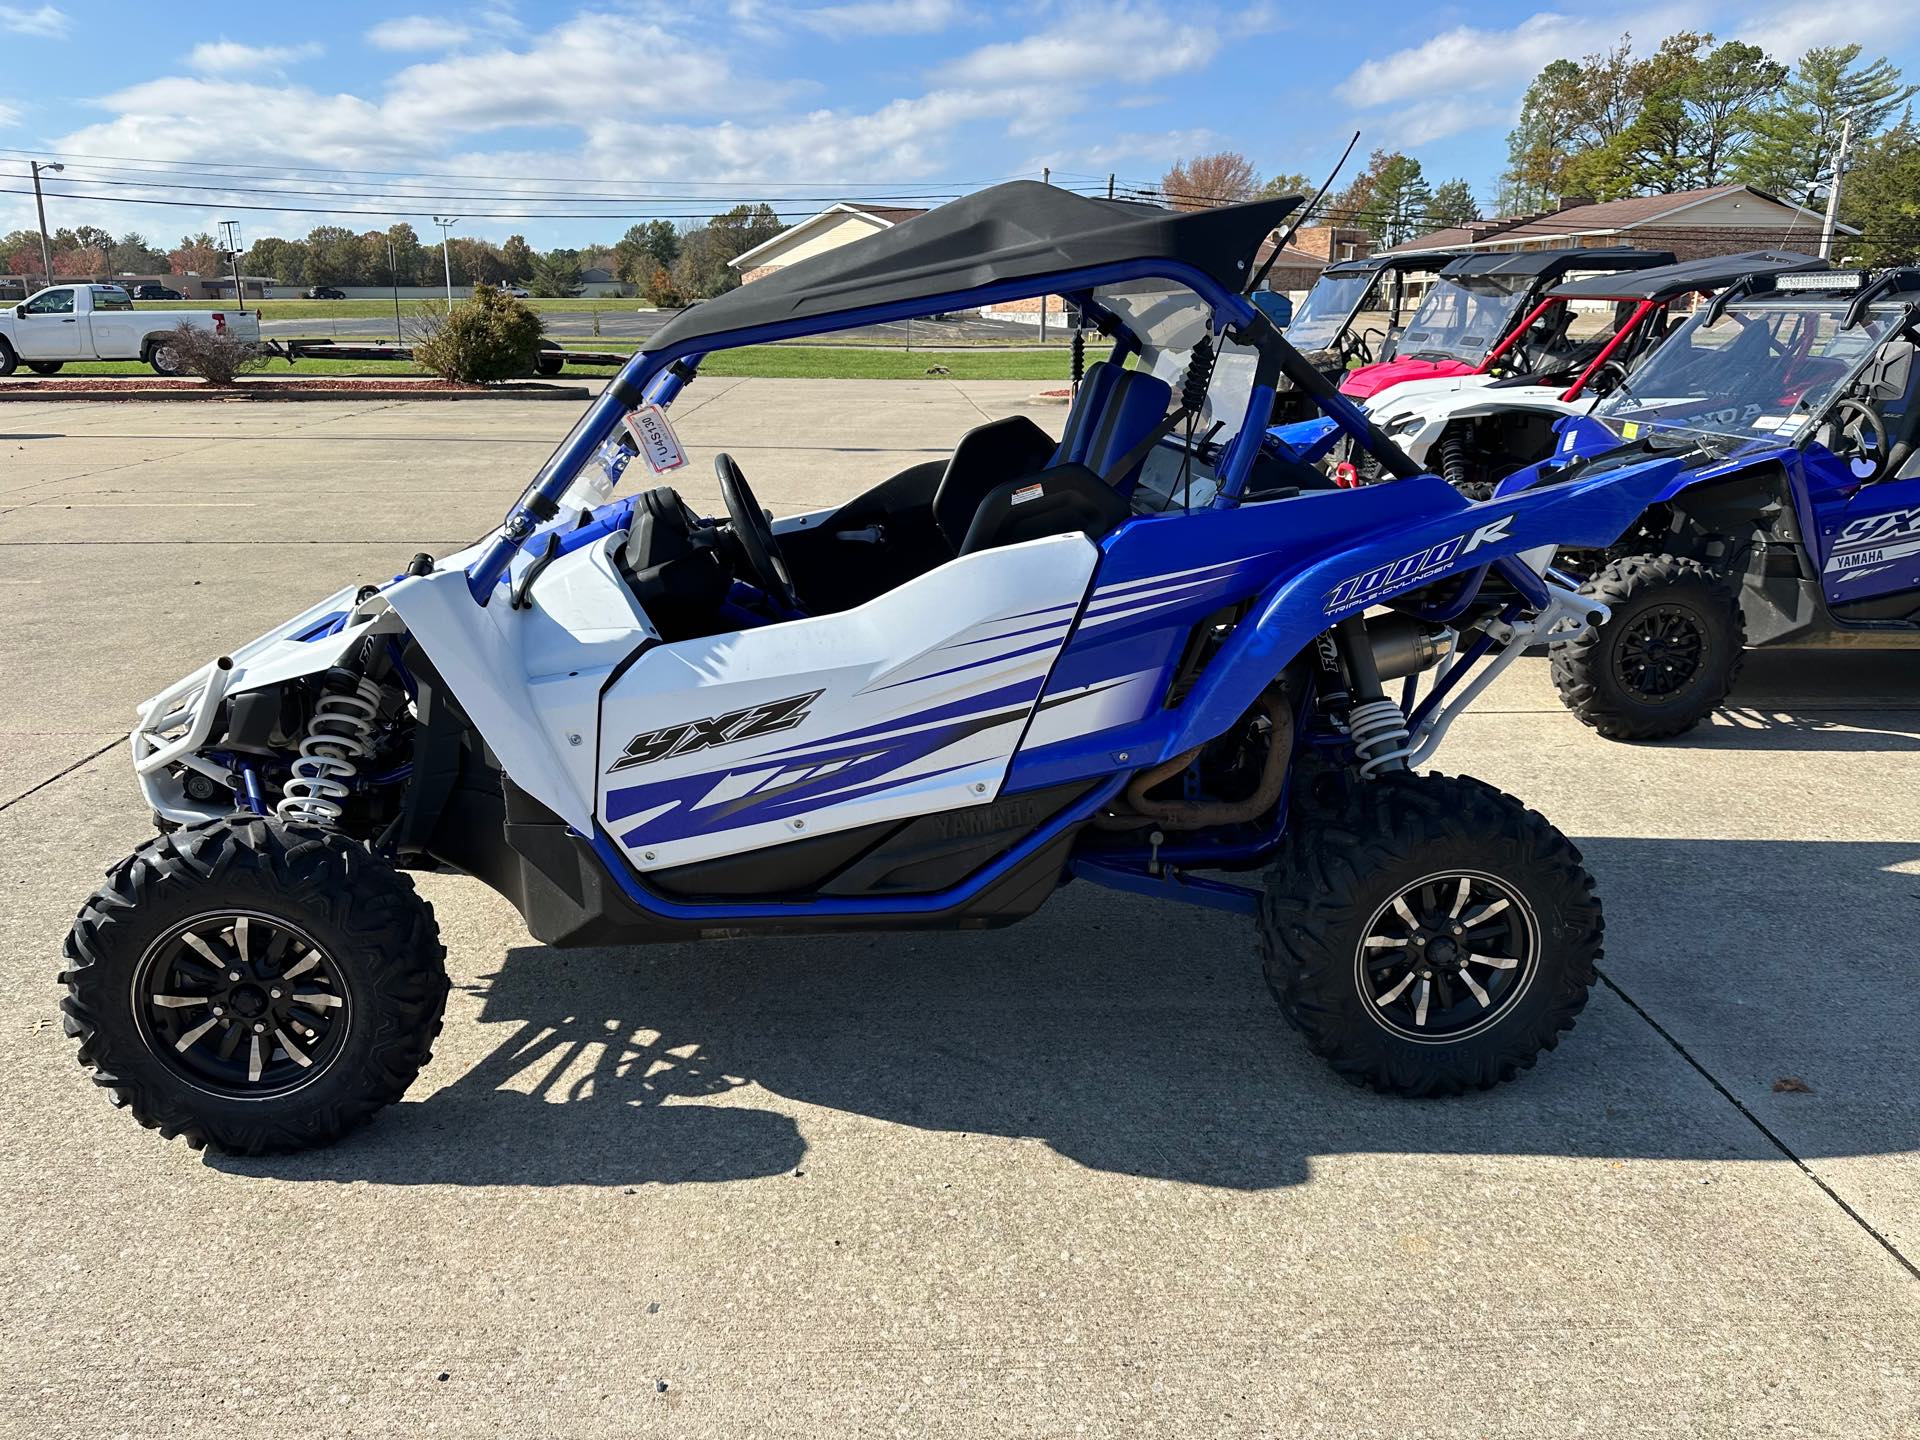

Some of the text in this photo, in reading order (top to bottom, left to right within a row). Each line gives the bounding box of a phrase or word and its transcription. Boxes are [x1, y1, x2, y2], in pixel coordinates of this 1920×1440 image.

[641, 417, 668, 456] U4S130
[1834, 508, 1920, 544] YX
[1836, 549, 1884, 569] YAMAHA
[1324, 562, 1455, 617] TRIPLE-CYLINDER
[605, 687, 827, 774] YXZ
[934, 799, 1040, 839] YAMAHA
